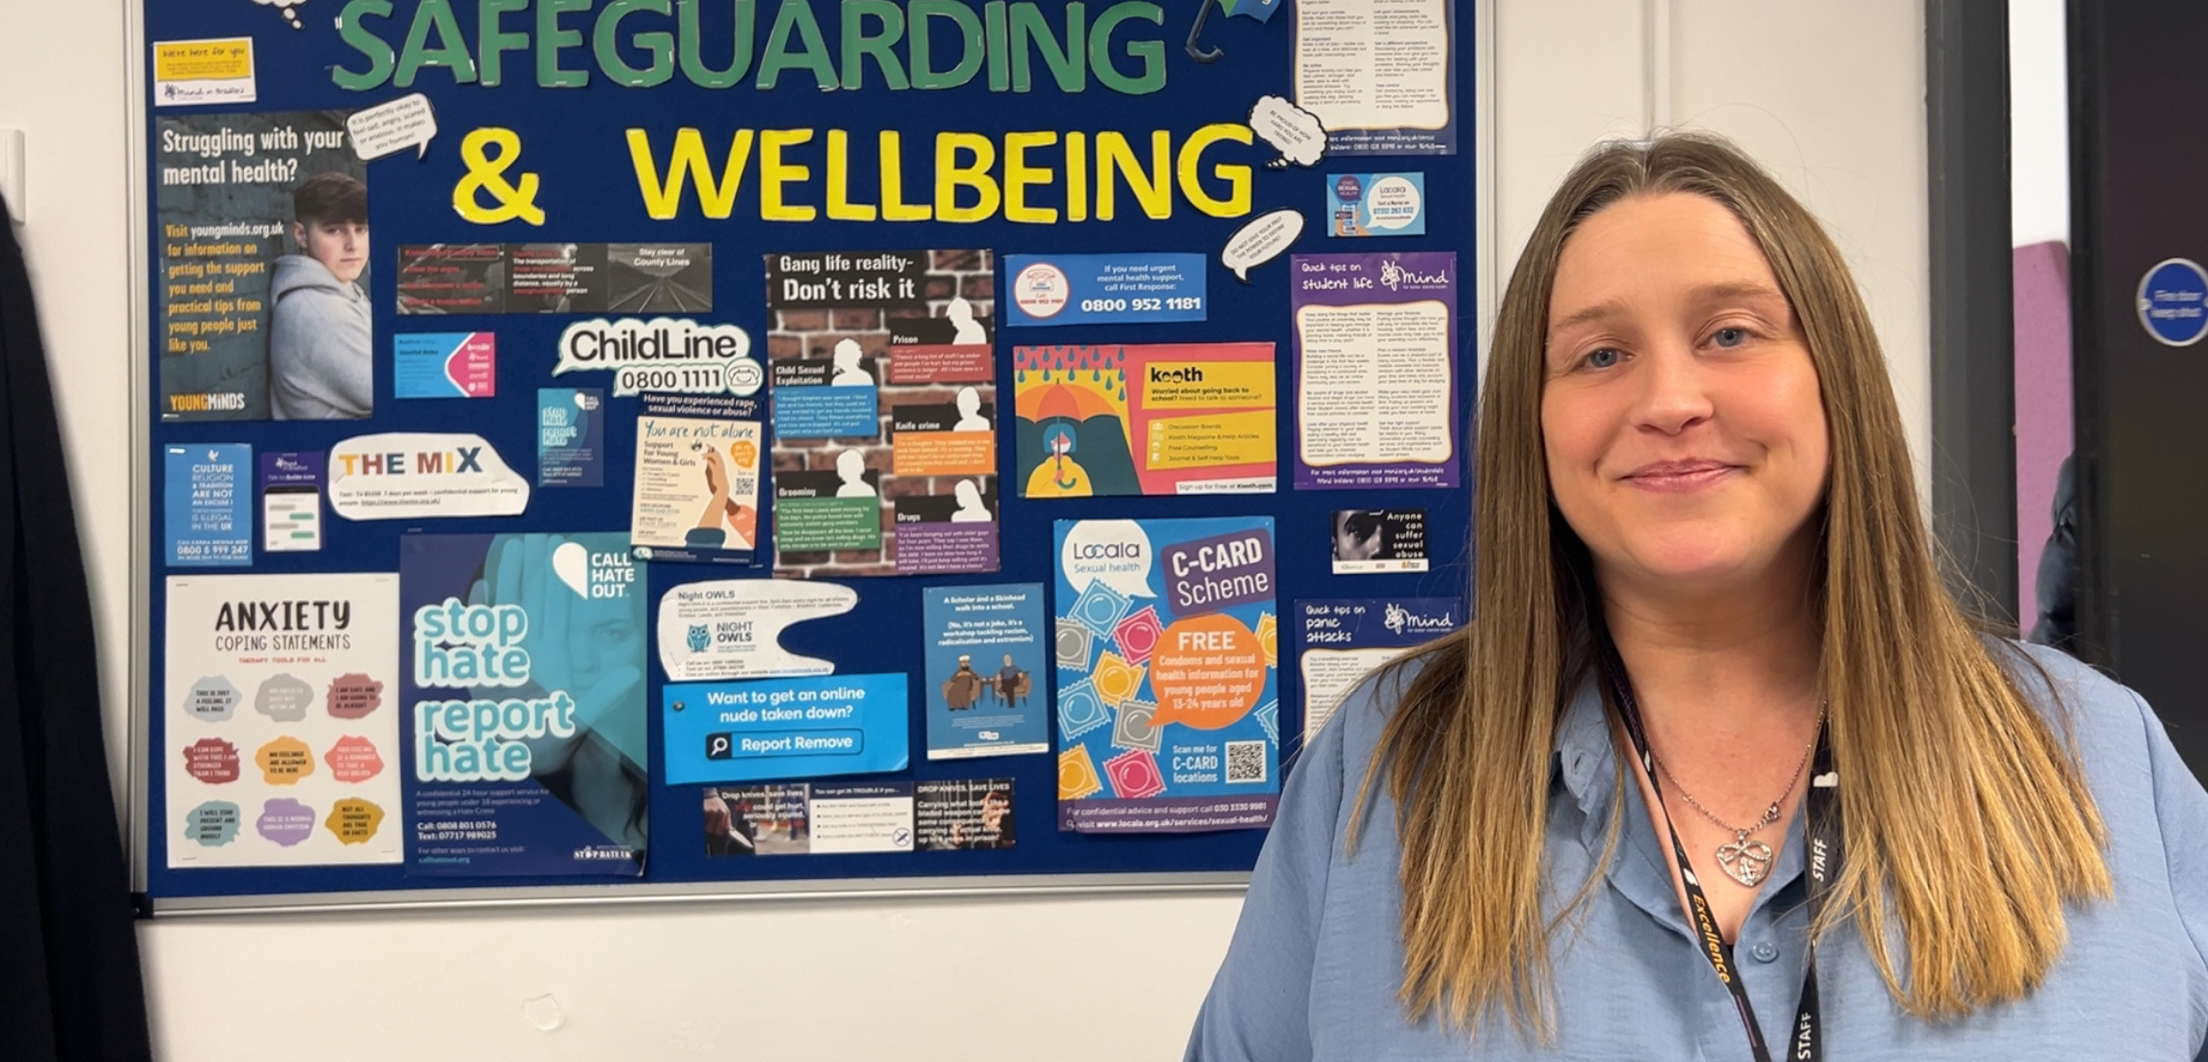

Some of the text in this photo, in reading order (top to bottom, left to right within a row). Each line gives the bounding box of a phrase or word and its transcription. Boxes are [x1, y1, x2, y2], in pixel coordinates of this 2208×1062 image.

[332, 0, 1167, 94] SAFEGUARDING
[163, 126, 344, 157] Struggling with your
[164, 158, 297, 185] mental health?
[453, 123, 1254, 226] & WELLBEING
[166, 221, 284, 240] Visit youngminds.org.uk
[168, 243, 256, 256] for information on
[639, 247, 684, 258] Stay clear of
[169, 262, 264, 278] getting the support
[634, 257, 690, 268] County Lines
[780, 254, 914, 274] Gang life reality-
[1112, 266, 1127, 274] you
[1150, 265, 1176, 273] urgent
[1302, 262, 1326, 273] Quick
[1330, 263, 1346, 273] tips
[1097, 274, 1123, 282] mental
[1152, 274, 1184, 282] support,
[1302, 277, 1373, 290] student life
[169, 280, 233, 297] you need and
[783, 277, 915, 300] Don't risk it
[1105, 283, 1118, 291] call
[1138, 283, 1177, 292] Response:
[169, 299, 261, 316] practical tips from
[1081, 297, 1201, 312] 0800 952 1181
[169, 318, 256, 334] young people just
[170, 338, 210, 353] like you.
[571, 328, 736, 361] ChildLine
[893, 335, 918, 344] Prison
[622, 370, 720, 389] 0800 1111
[1151, 367, 1203, 384] kooth
[1203, 388, 1222, 396] going
[644, 394, 757, 409] Have you experienced rape,
[649, 404, 675, 413] sexual
[677, 404, 710, 414] violence
[723, 406, 752, 416] abuse?
[645, 420, 753, 439] You are not alone
[896, 421, 917, 430] Knife
[192, 464, 233, 473] CULTURE
[338, 447, 482, 476] THE MIX
[193, 490, 232, 498] ARE NOT
[779, 488, 816, 497] Grooming
[898, 514, 921, 522] Drugs
[1387, 512, 1422, 521] Anyone
[1406, 522, 1422, 530] can
[1395, 531, 1423, 539] suffer
[1074, 542, 1140, 560] Locala
[1393, 540, 1423, 549] sexual
[592, 552, 632, 567] CALL
[1172, 538, 1262, 577] C-CARD
[592, 568, 634, 582] HATE
[1074, 563, 1140, 573] Sexual health
[592, 584, 625, 597] OUT
[679, 590, 735, 601] Night OWLS
[1177, 572, 1269, 606] Scheme
[215, 600, 351, 631] ANXIETY
[1306, 605, 1365, 615] Quick tips on
[423, 601, 525, 647] stop
[717, 621, 753, 632] NIGHT
[1306, 619, 1341, 631] panic
[216, 634, 351, 651] COPING STATEMENTS
[717, 632, 752, 643] OWLS
[1178, 631, 1236, 650] FREE
[1307, 631, 1352, 642] attacks
[424, 640, 528, 679] hate
[1159, 654, 1256, 666] Condoms and sexual
[1156, 669, 1258, 680] health information for
[707, 687, 865, 706] Want to get an online
[1164, 683, 1251, 697] young people aged
[1173, 698, 1243, 711] 13-24 years old
[424, 694, 573, 742] report
[720, 706, 853, 722] nude taken down?
[742, 736, 853, 753] Report Remove
[424, 735, 529, 773] hate
[1173, 756, 1218, 770] C-CARD
[1173, 772, 1217, 783] locations
[1812, 838, 1828, 882] STAFF
[1692, 894, 1730, 983] Excellence
[1797, 1012, 1811, 1060] STAFF
